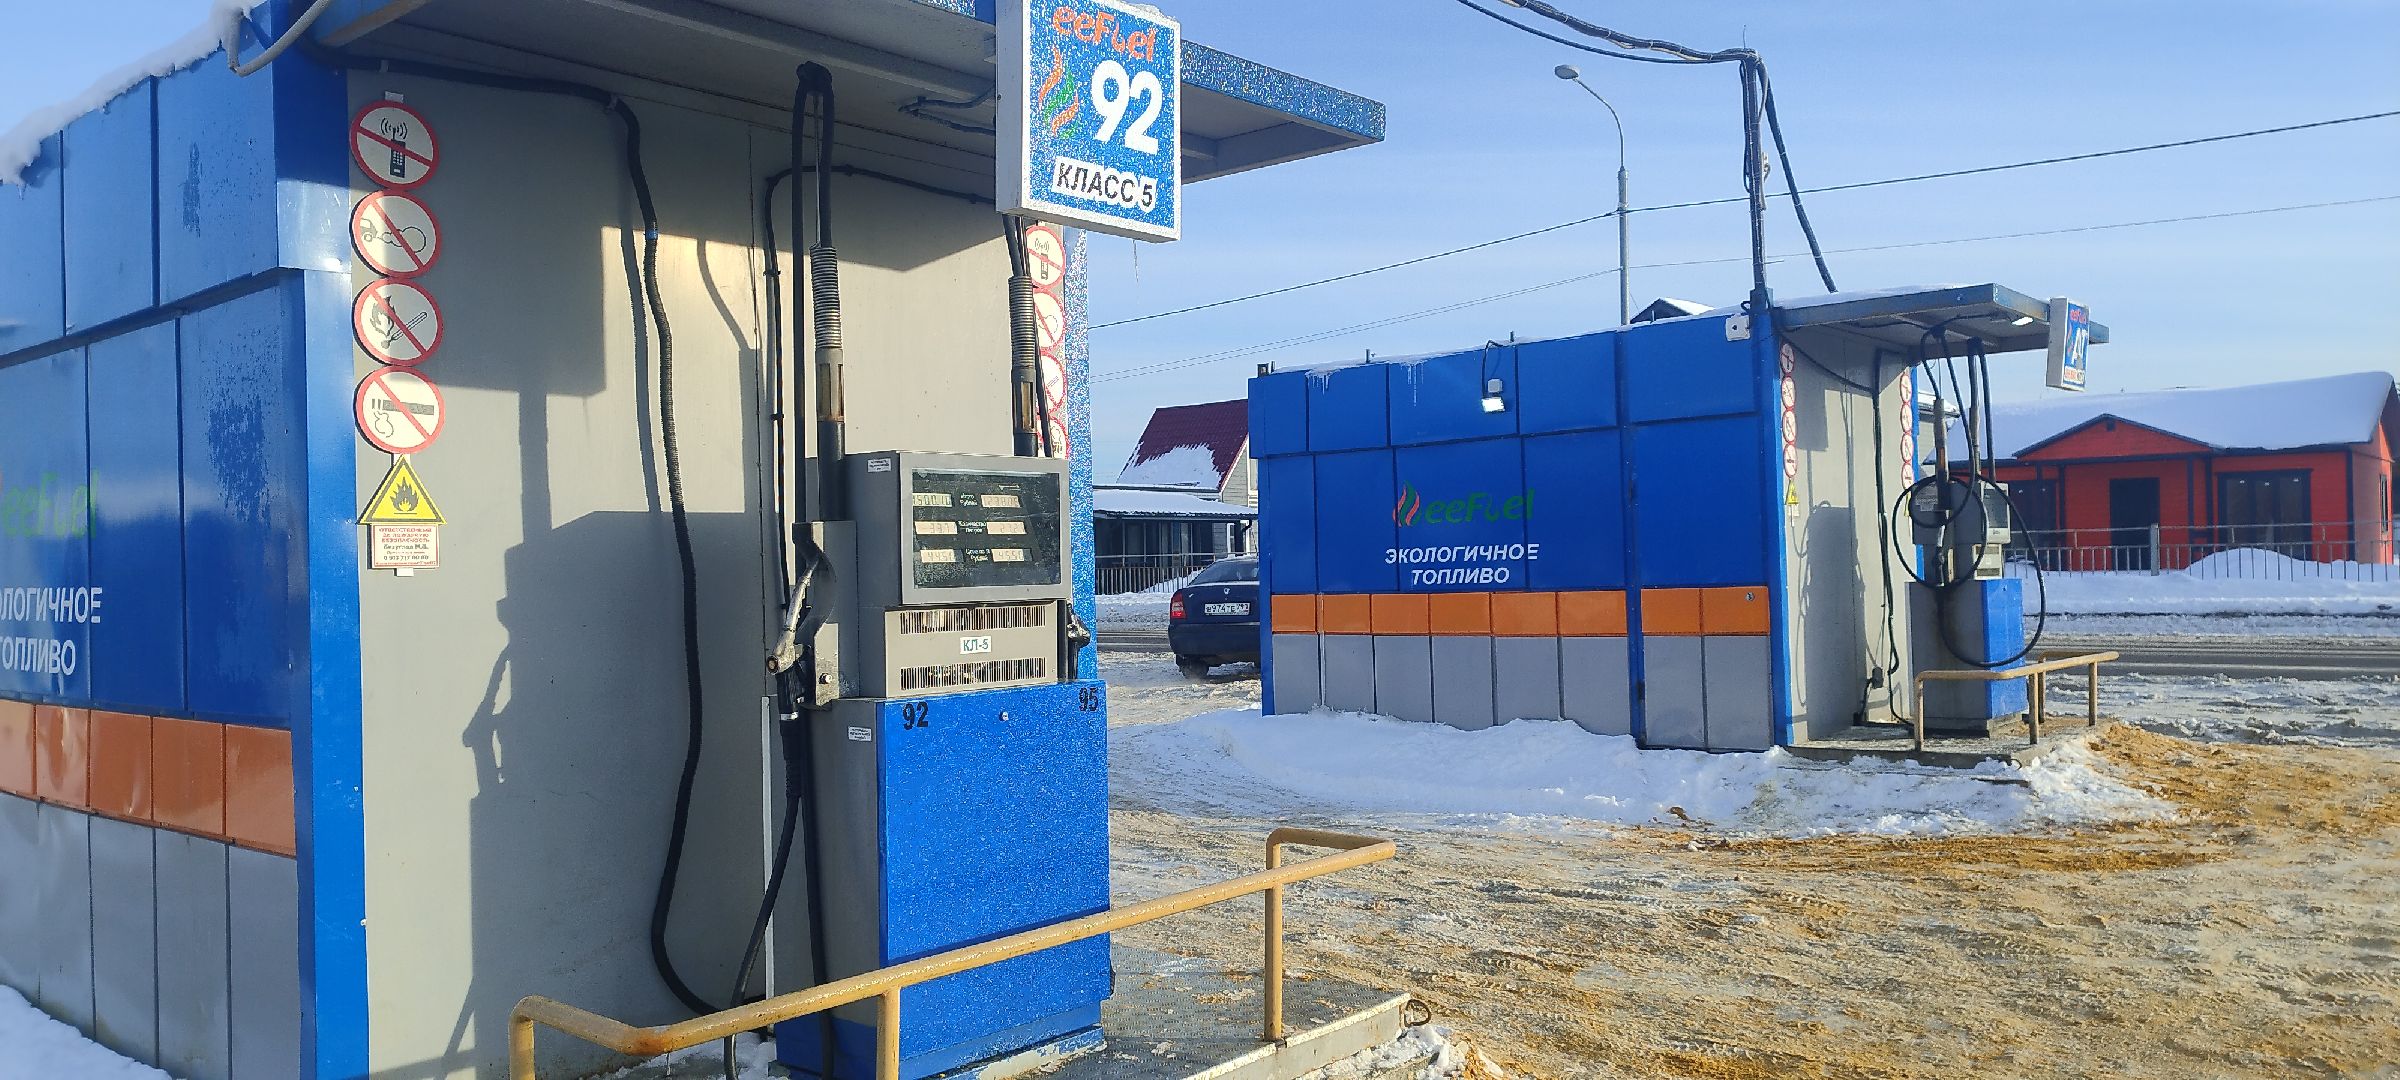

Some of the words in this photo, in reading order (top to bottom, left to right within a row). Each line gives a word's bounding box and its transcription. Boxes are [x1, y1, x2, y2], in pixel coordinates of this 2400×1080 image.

[1091, 59, 1163, 155] 92
[1056, 162, 1136, 203] КЛАСС
[1141, 183, 1154, 207] 5
[1385, 543, 1540, 565] ЭКОЛОГИЧНОЕ
[1411, 566, 1510, 586] ТОПЛИВО
[0, 586, 102, 624] ЛОГИЧНОЕ
[963, 638, 989, 652] КЛ-5
[903, 702, 929, 730] 92
[1078, 687, 1099, 712] 95
